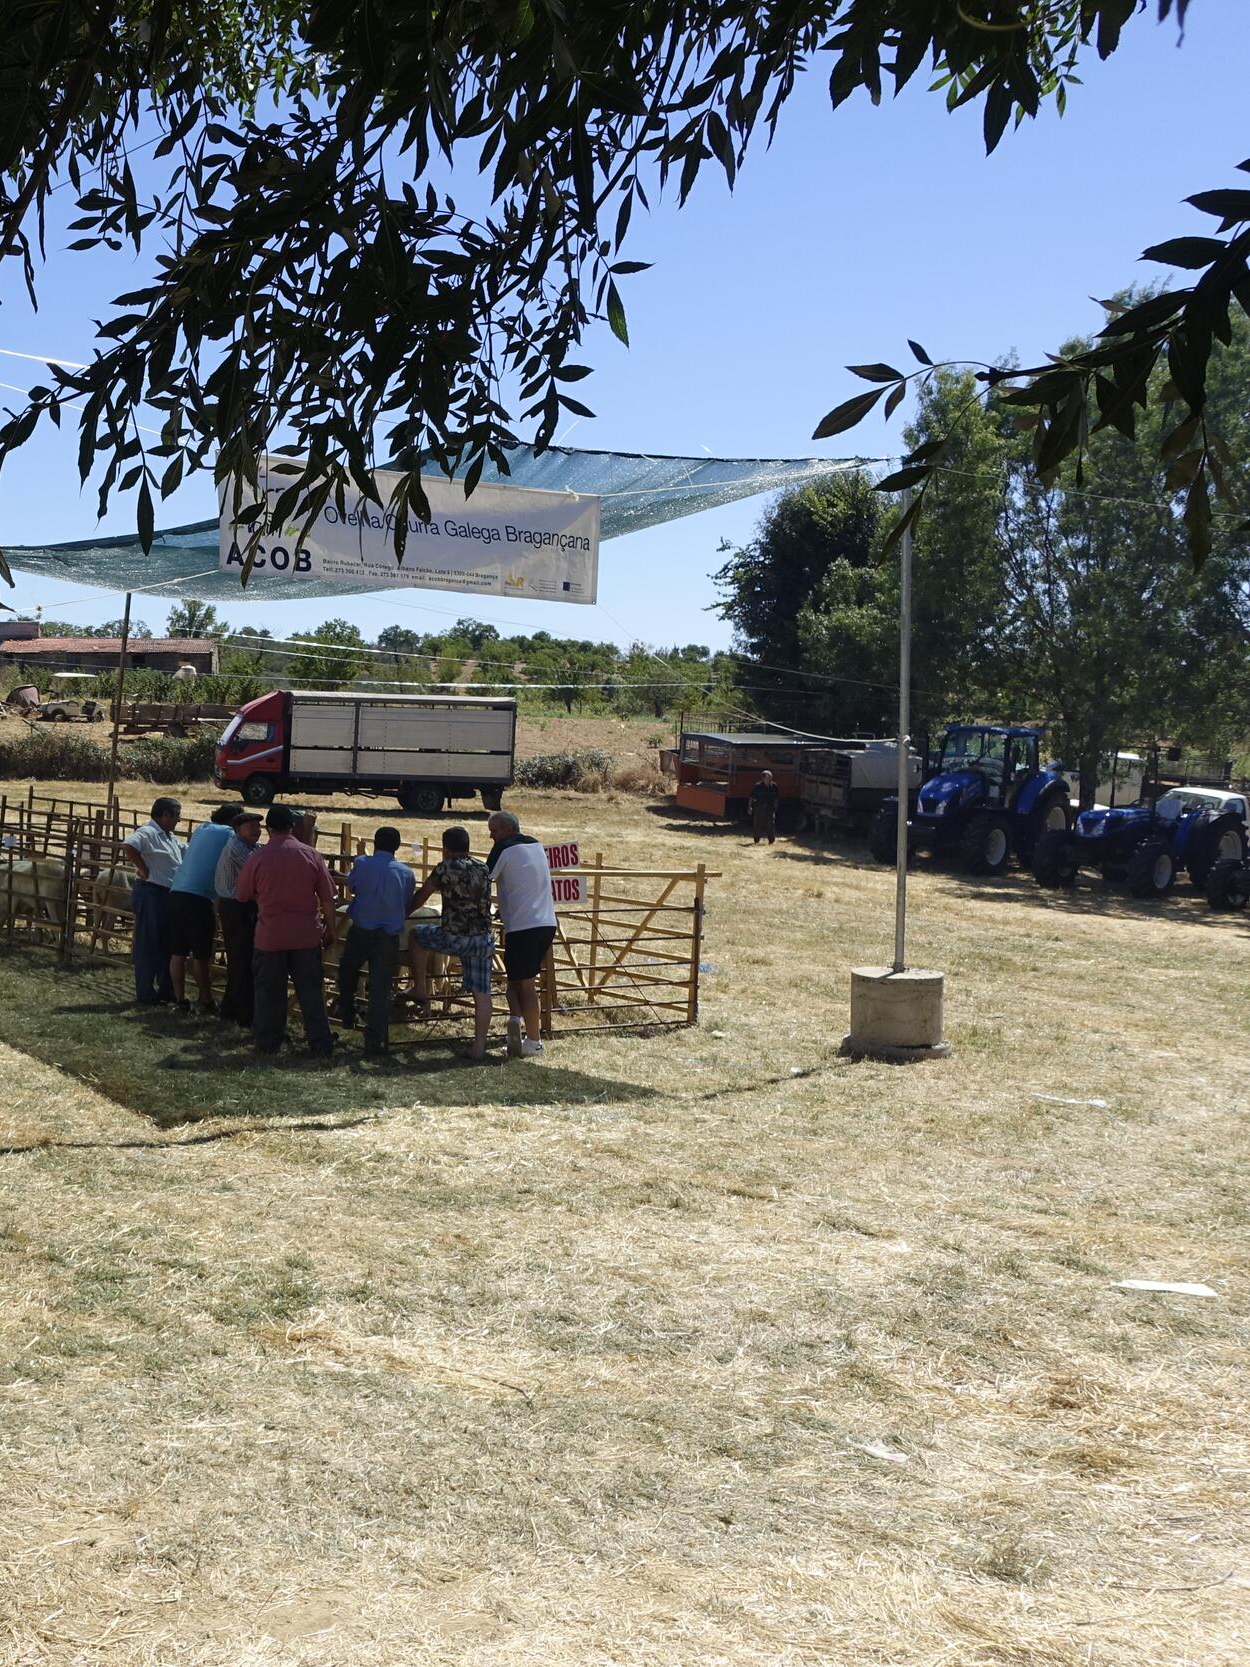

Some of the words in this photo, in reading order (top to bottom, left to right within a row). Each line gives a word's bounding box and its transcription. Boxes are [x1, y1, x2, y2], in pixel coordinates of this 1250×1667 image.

[444, 520, 501, 544] Galega
[505, 525, 590, 552] Bragançana
[226, 541, 312, 572] ACOB
